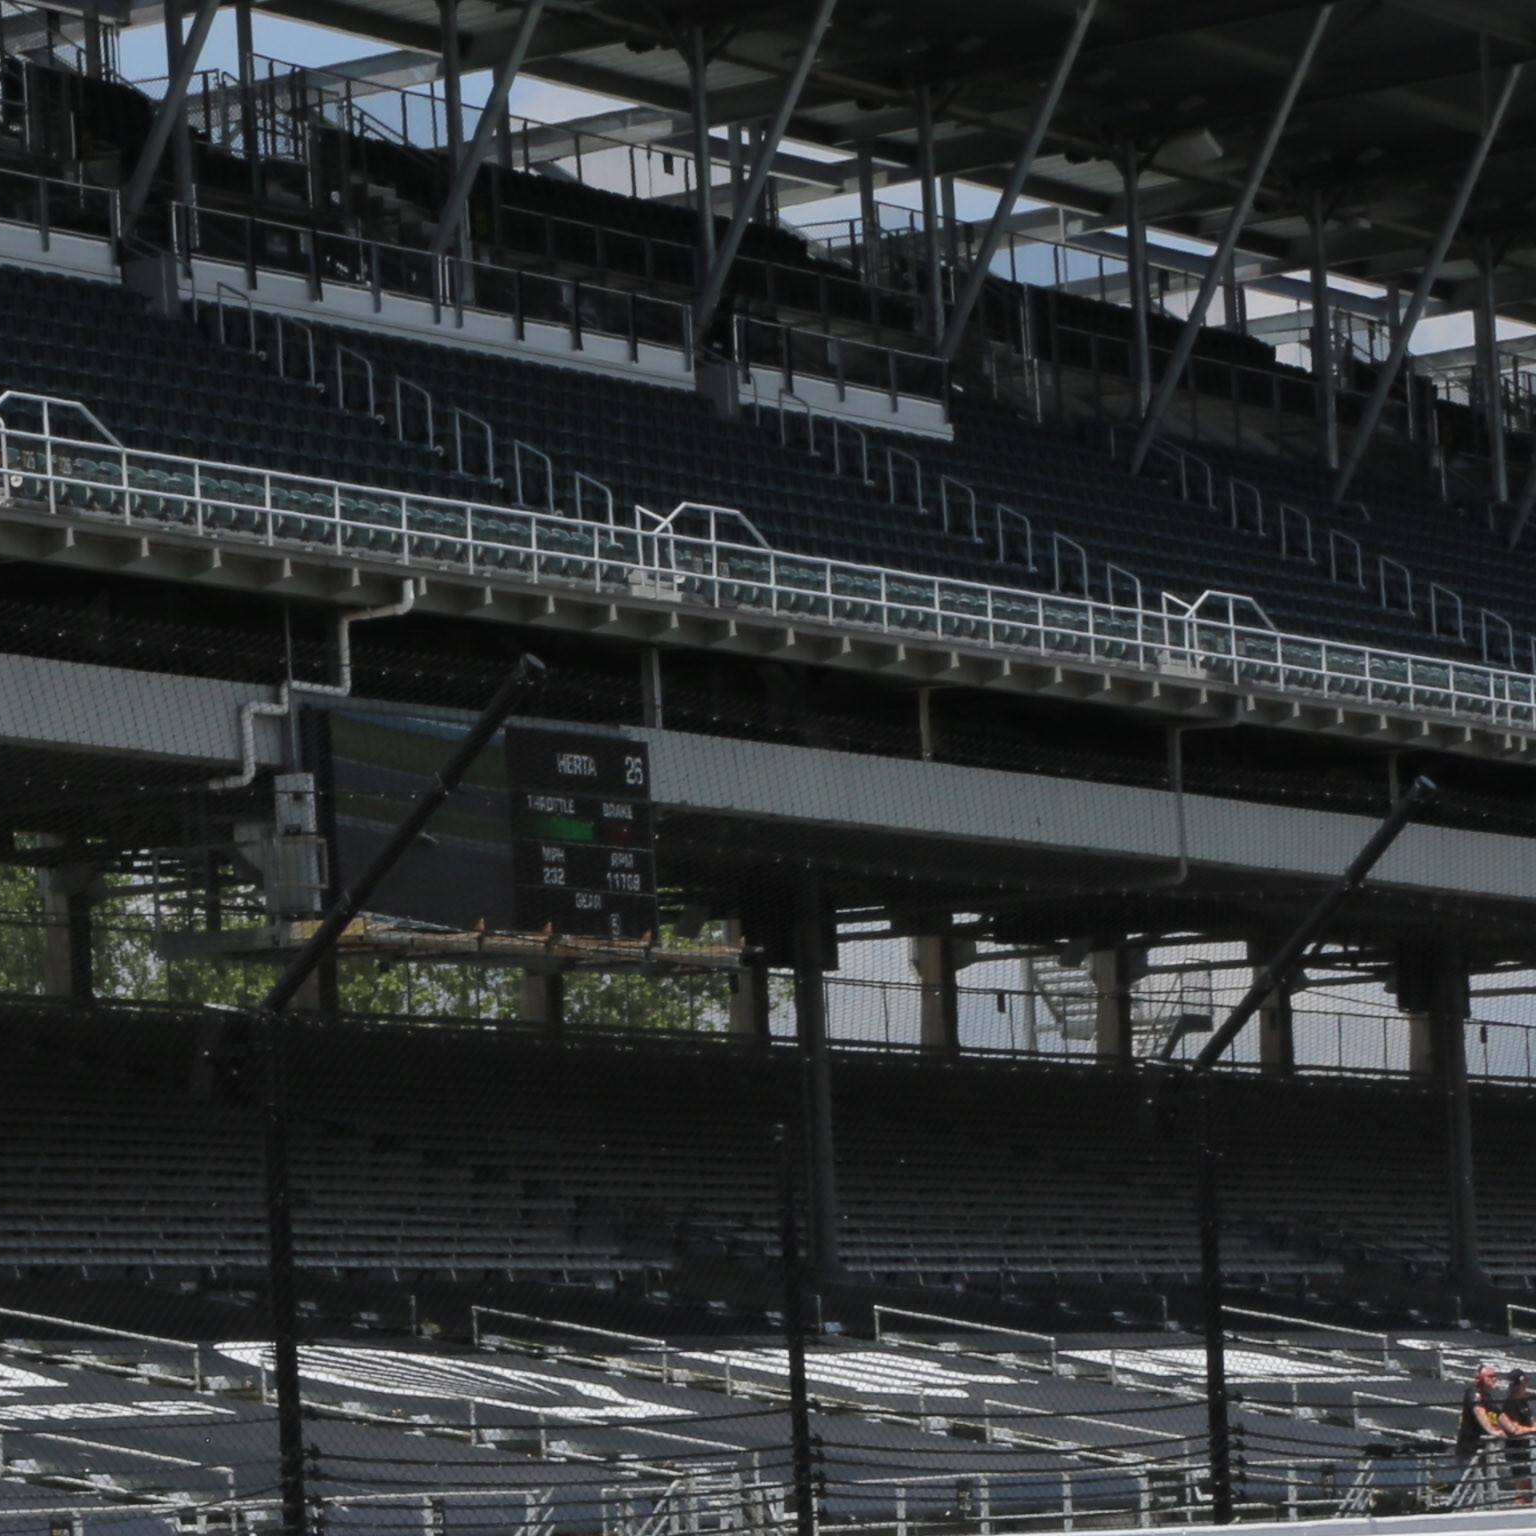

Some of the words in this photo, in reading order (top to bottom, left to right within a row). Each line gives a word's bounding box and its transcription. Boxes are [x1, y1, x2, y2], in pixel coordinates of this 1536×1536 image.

[556, 752, 597, 777] HERTA
[624, 756, 644, 785] 26
[527, 794, 575, 814] THROTTLE
[542, 846, 565, 862] MPH
[611, 852, 634, 868] RPM
[543, 867, 566, 885] 232
[575, 892, 602, 910] GEAR
